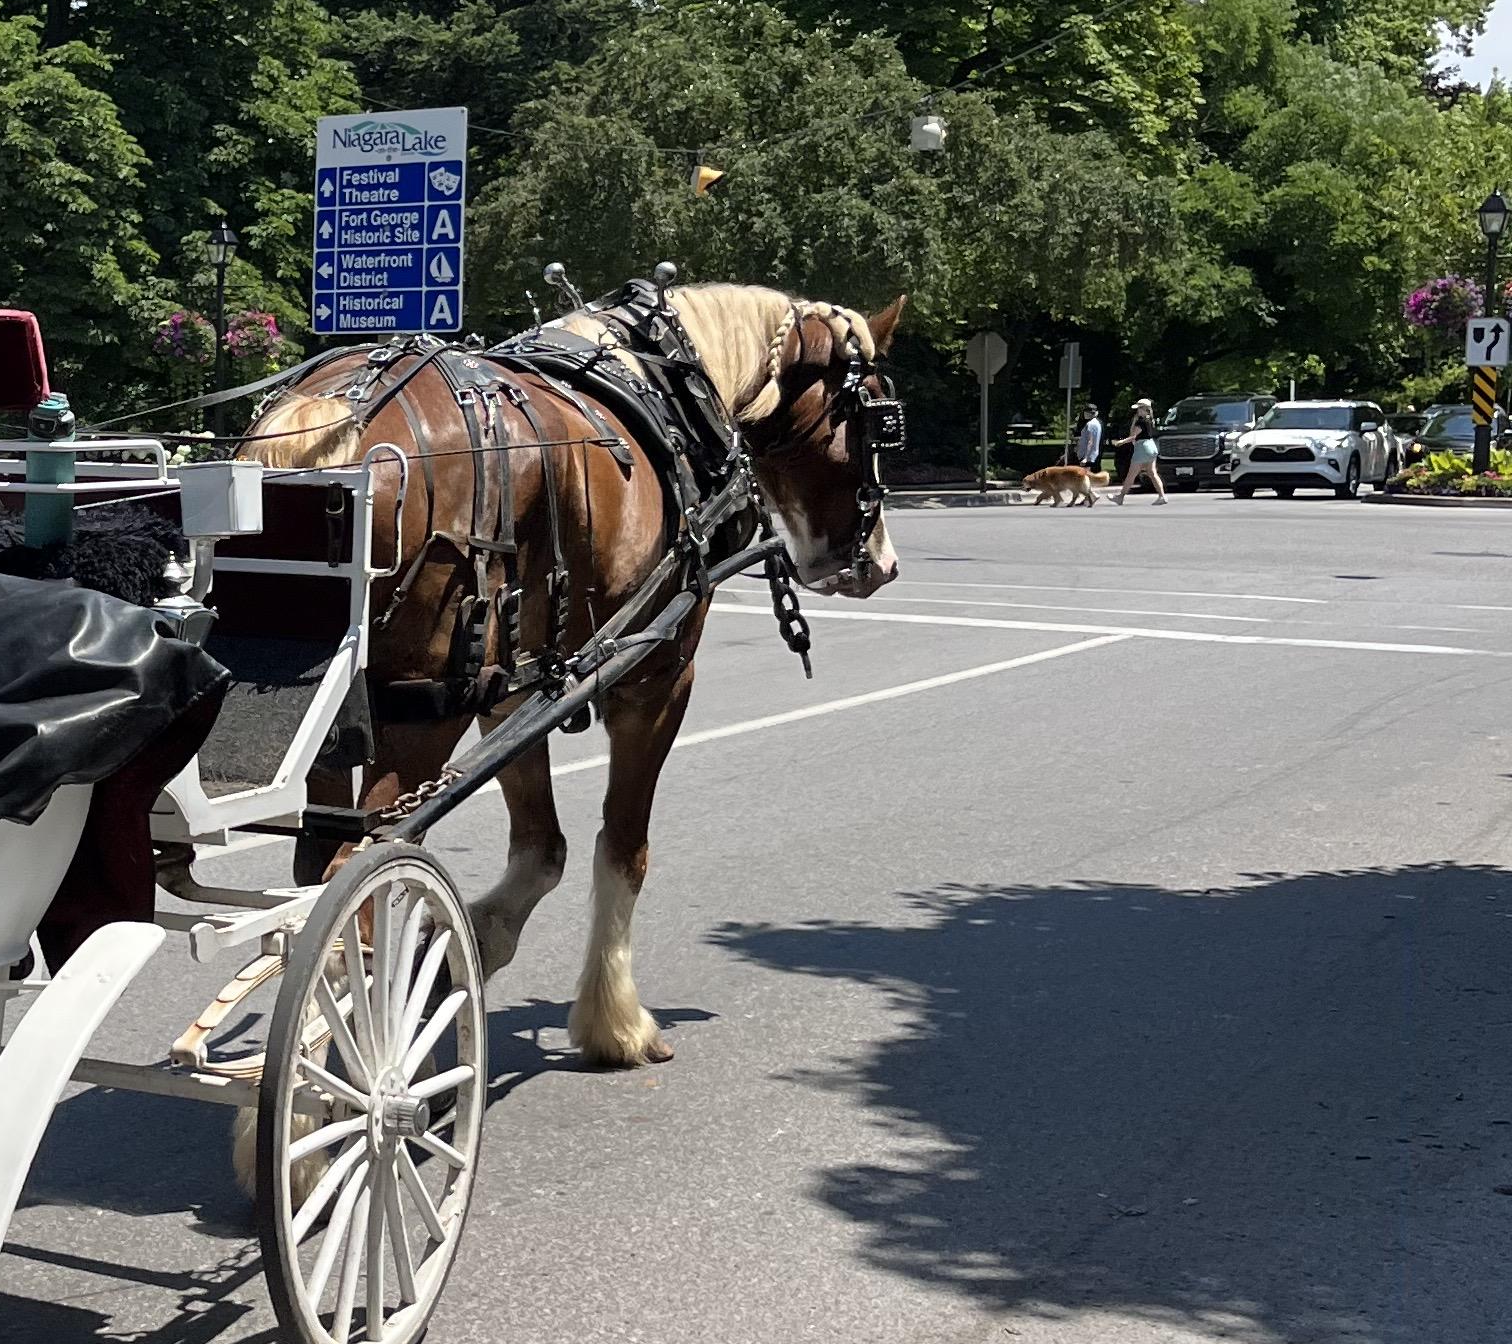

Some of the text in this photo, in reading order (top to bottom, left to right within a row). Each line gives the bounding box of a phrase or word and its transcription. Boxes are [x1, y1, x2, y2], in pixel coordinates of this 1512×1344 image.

[332, 127, 447, 153] Niagara Lake
[342, 167, 399, 186] Festival
[342, 187, 399, 204] Theatre
[341, 209, 419, 228] Fort George
[341, 226, 420, 245] Historic Site
[340, 253, 413, 269] Waterfront
[339, 271, 388, 287] District
[339, 294, 404, 311] Historical
[339, 313, 396, 329] Museum
